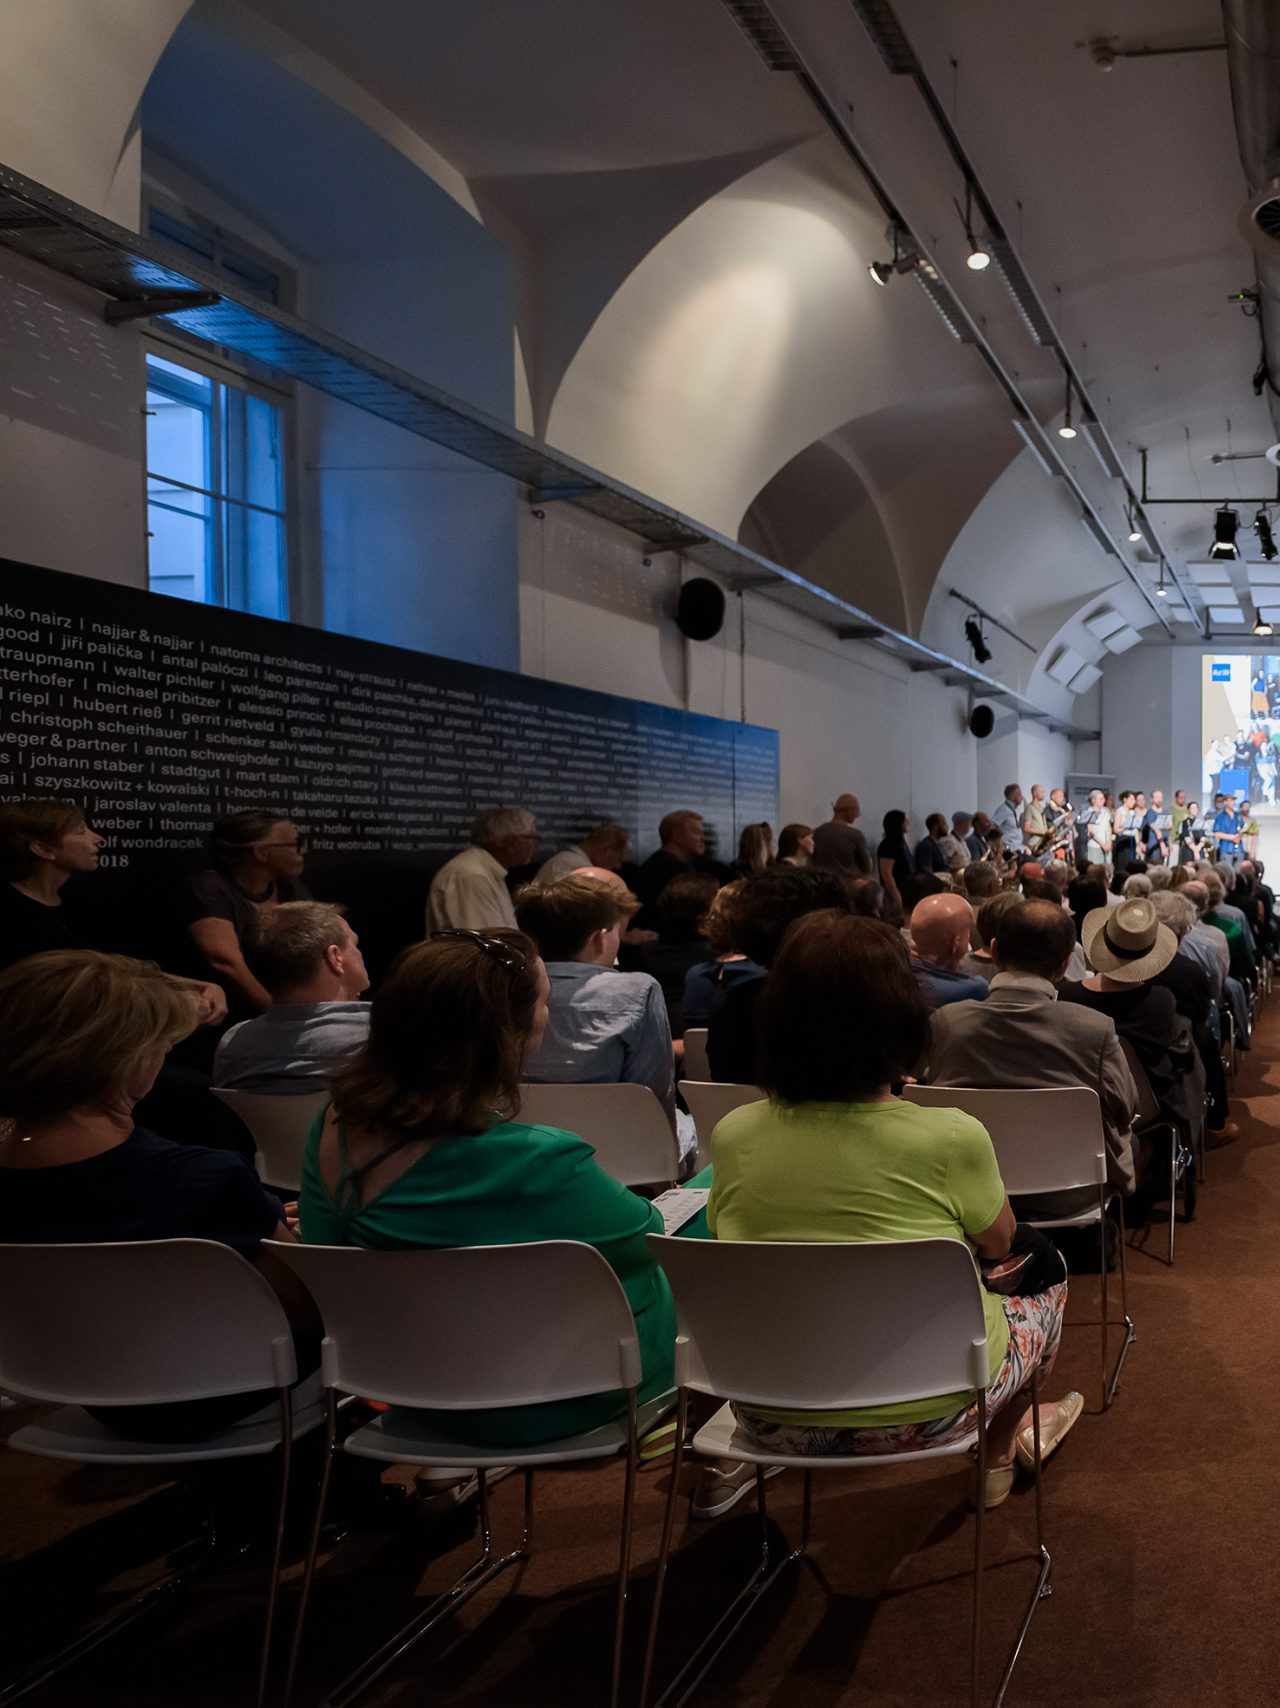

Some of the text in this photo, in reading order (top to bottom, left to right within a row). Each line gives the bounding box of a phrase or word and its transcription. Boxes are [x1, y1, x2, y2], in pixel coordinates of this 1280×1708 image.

[30, 612, 323, 674] nairz najjar & najjar natoma architects
[88, 641, 371, 698] palička antal palóczi leo parenzan dirk
[114, 665, 162, 681] walter
[166, 672, 215, 689] pichler
[231, 684, 290, 703] wolfgang
[292, 692, 321, 705] piller
[9, 689, 49, 707] riepl
[73, 696, 128, 715] hubert
[132, 704, 163, 719] rieß
[182, 712, 220, 726] gerrit
[225, 717, 275, 732] rietveld
[290, 725, 322, 738] gyula
[97, 682, 157, 700] michael
[162, 690, 220, 707] pribitzer
[238, 700, 283, 717] alessio
[340, 715, 362, 728] elsa
[10, 710, 93, 730] christoph
[97, 720, 188, 740] scheithauer
[206, 732, 266, 748] schenker
[269, 738, 297, 752] salvi
[299, 743, 335, 755] weber
[30, 753, 89, 769] johann
[93, 758, 144, 773] staber
[162, 763, 220, 780] stadtgut
[236, 770, 267, 782] mart
[269, 774, 300, 784] stam
[50, 733, 62, 747] &
[66, 737, 127, 752] partner
[145, 744, 187, 758] anton
[191, 746, 280, 766] schweighofer
[294, 758, 334, 772] kazuyo
[336, 762, 370, 775] sejima
[34, 775, 132, 791] szyszkowitz
[135, 783, 144, 791] +
[148, 780, 210, 796] kowalski
[292, 790, 343, 803] takaharu
[95, 796, 156, 812] jaroslav
[159, 801, 211, 814] valenta
[290, 806, 306, 817] de
[308, 807, 339, 818] velde
[92, 816, 142, 829] weber
[159, 818, 214, 831] thomas
[324, 823, 352, 834] hofer
[122, 836, 381, 850] wondracek fritz wotruba
